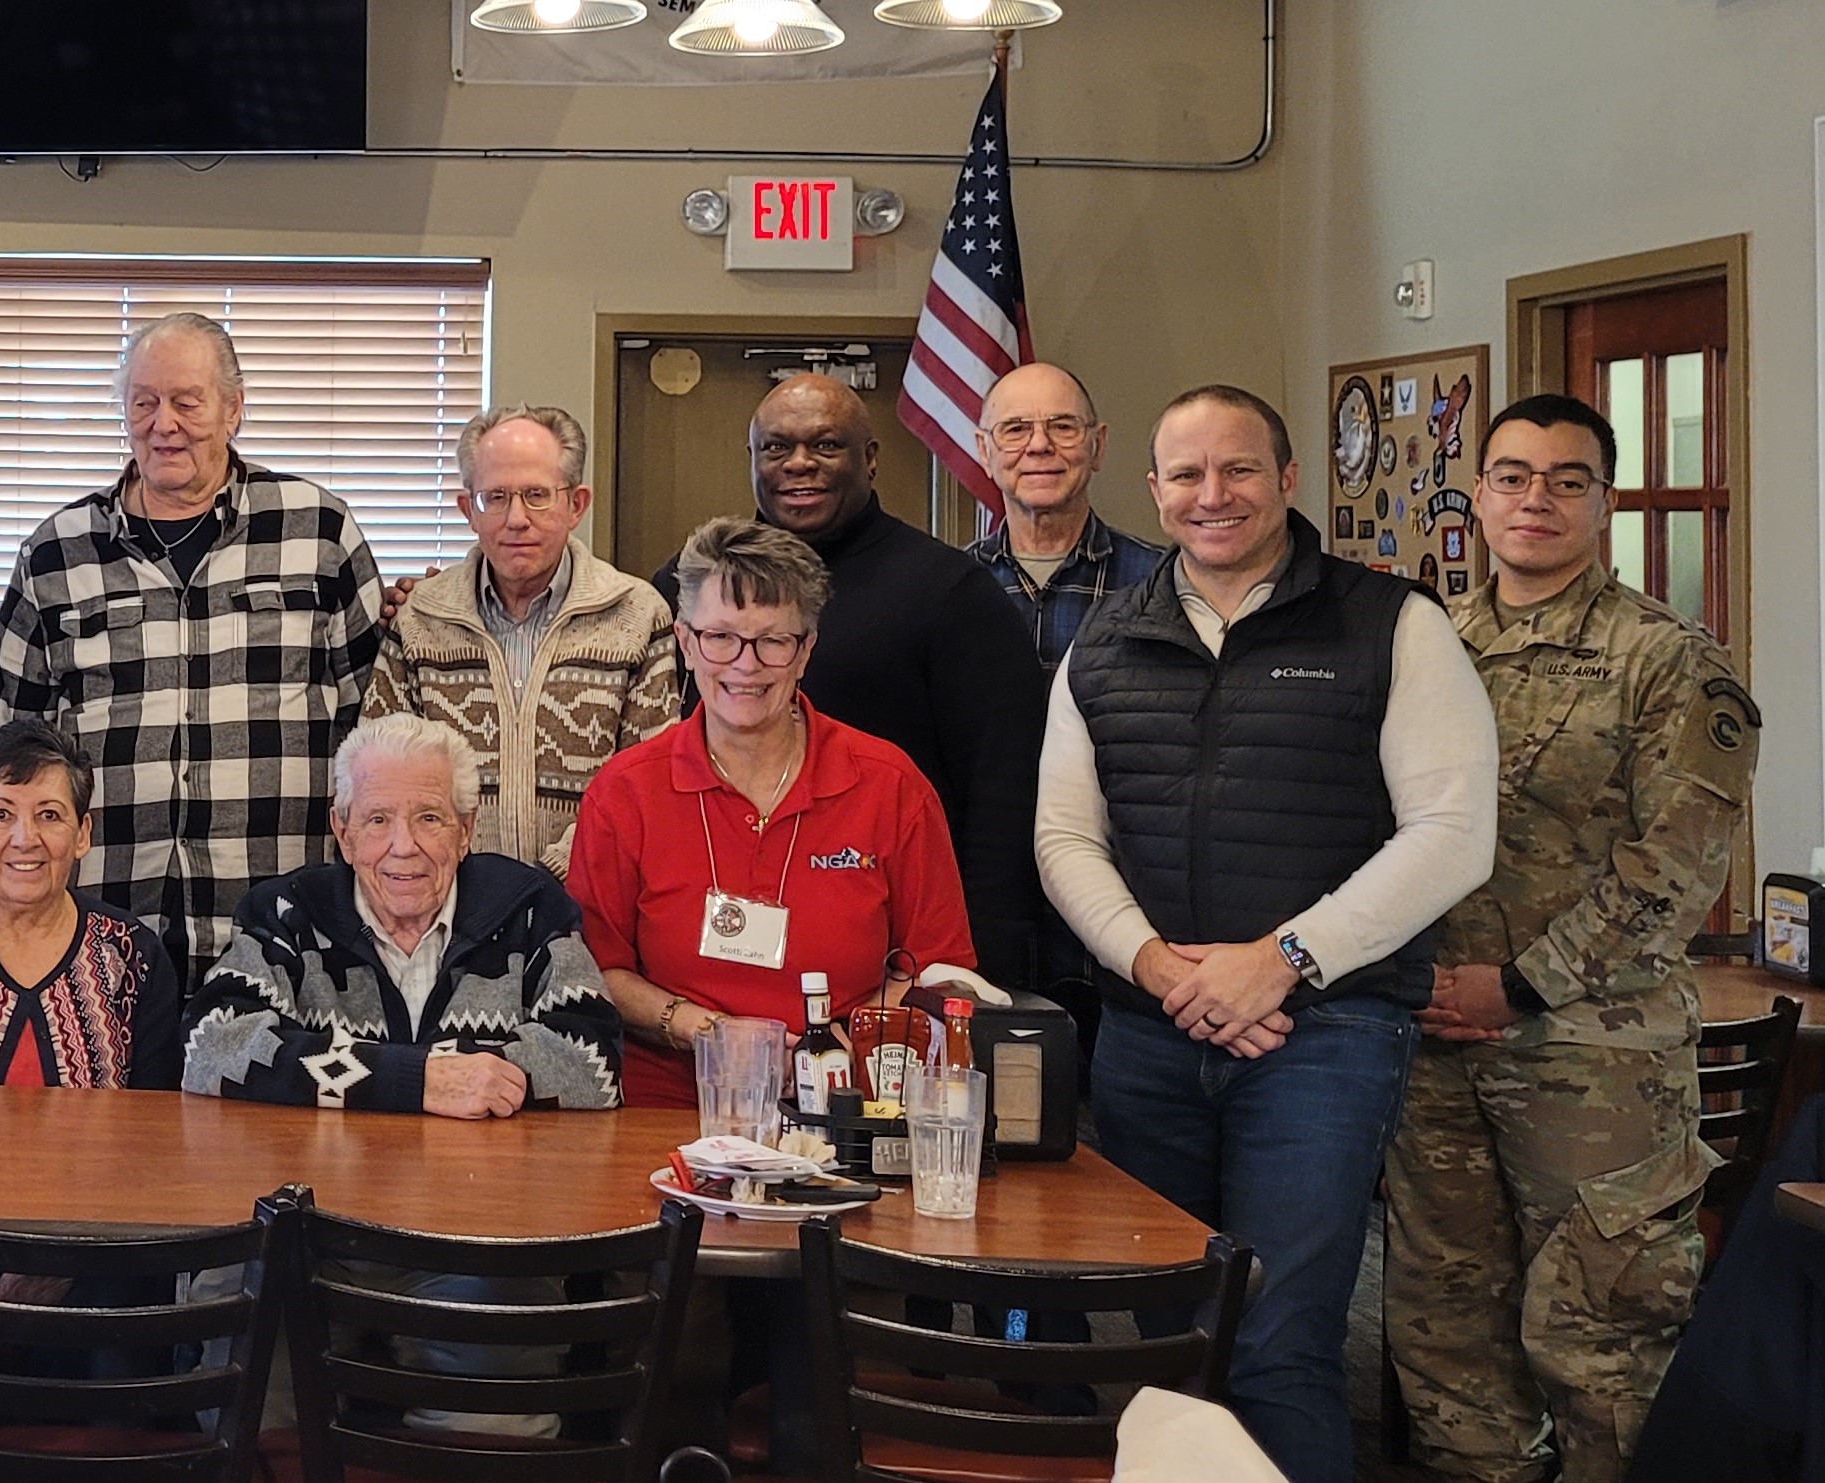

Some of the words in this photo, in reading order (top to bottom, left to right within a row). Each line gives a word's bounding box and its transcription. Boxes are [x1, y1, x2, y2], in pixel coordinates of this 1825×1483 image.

[754, 182, 836, 241] EXIT
[1282, 667, 1335, 680] Columbia
[1572, 665, 1612, 680] ARMY
[883, 1051, 905, 1059] HEIN
